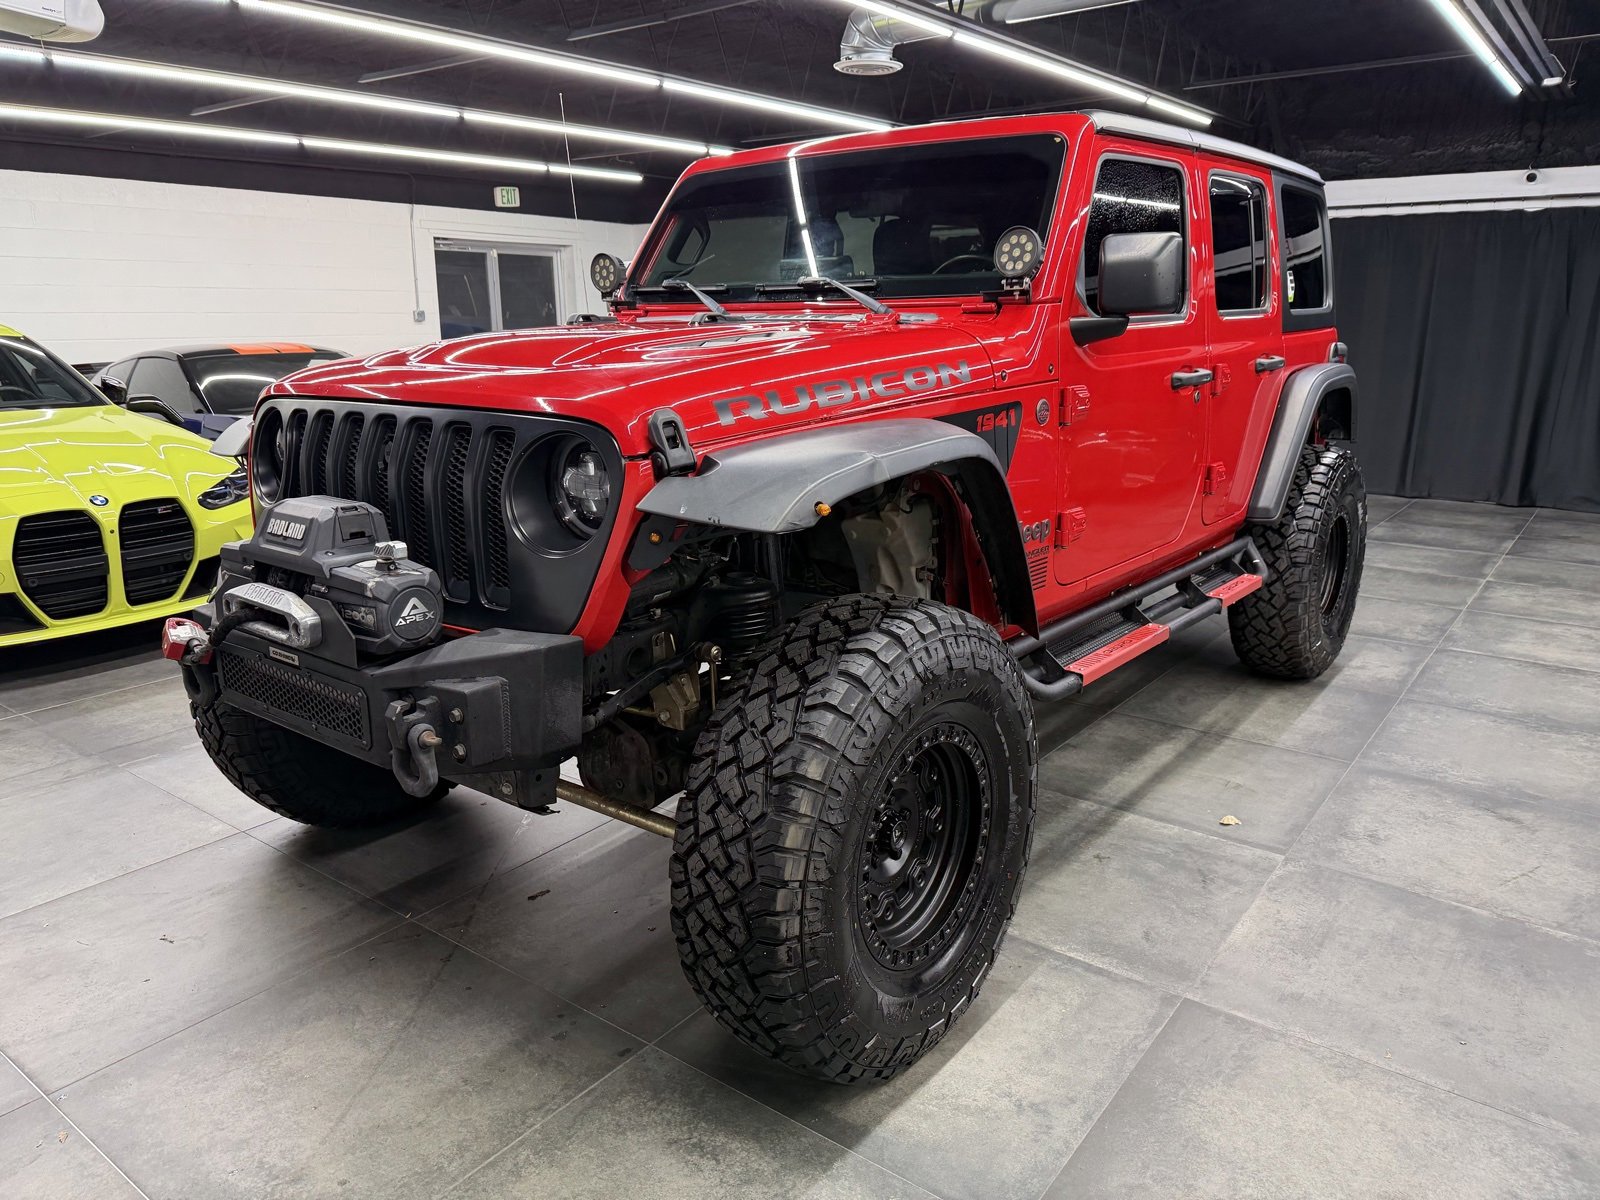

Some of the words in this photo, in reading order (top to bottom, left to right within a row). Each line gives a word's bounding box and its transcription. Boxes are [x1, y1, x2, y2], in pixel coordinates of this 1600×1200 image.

[501, 188, 516, 204] EXIT
[714, 360, 972, 427] RUBICON
[976, 408, 1016, 433] 1941
[267, 518, 306, 540] BADLAND
[395, 611, 435, 627] APEX
